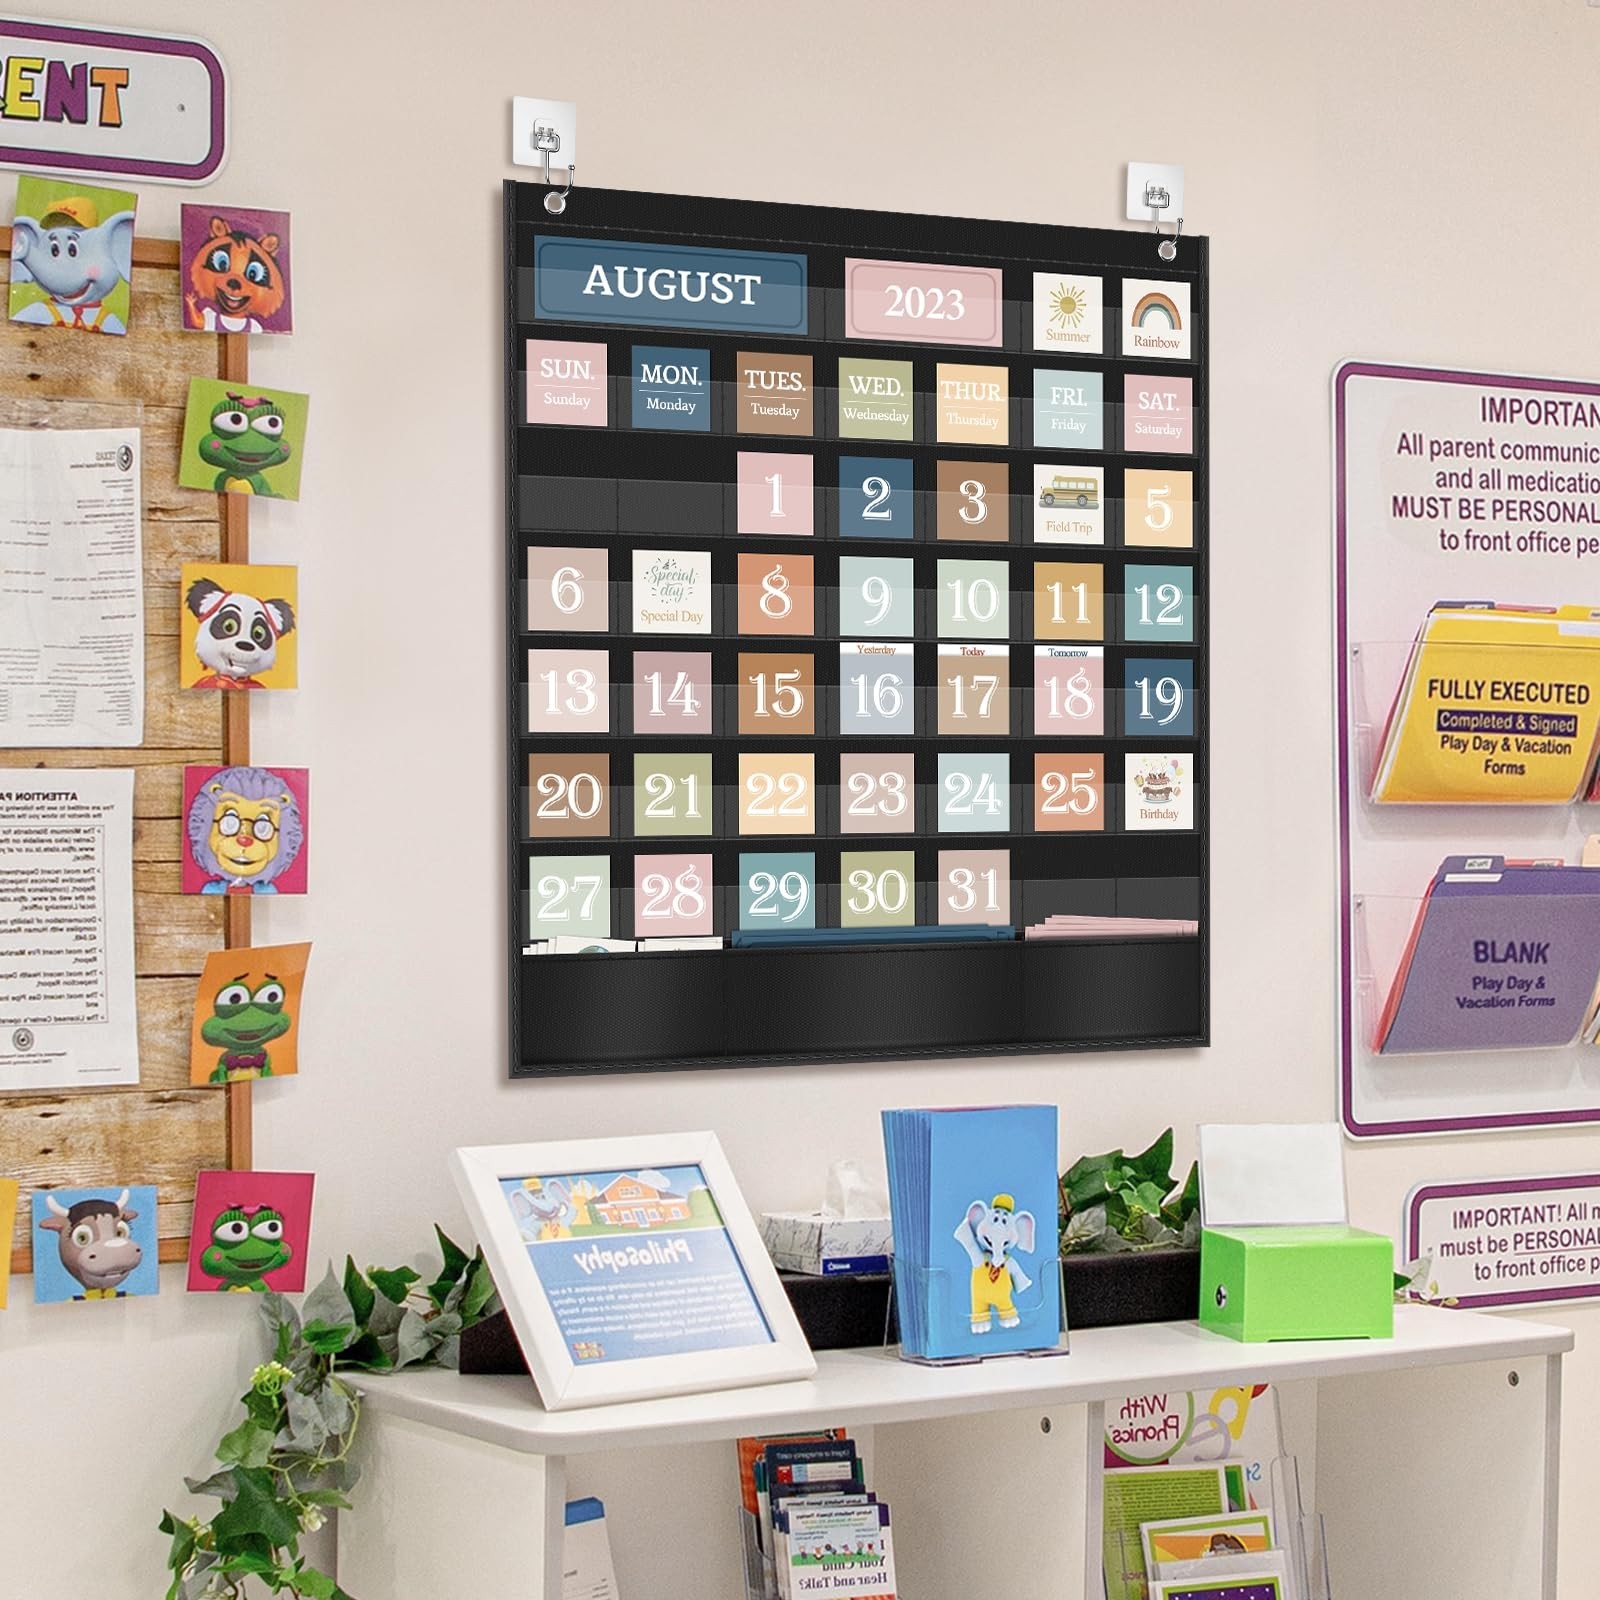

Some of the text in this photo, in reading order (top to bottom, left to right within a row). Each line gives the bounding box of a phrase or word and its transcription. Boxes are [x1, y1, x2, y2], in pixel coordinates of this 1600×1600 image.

[0, 56, 129, 128] ENT
[582, 264, 761, 307] AUGUST
[884, 285, 965, 322] 2023
[1046, 328, 1091, 343] Summer
[1134, 335, 1181, 350] Rainbow
[540, 358, 595, 381] SUN.
[640, 363, 703, 387] MON.
[744, 369, 807, 393] TUES.
[848, 375, 905, 398] WED.
[1050, 386, 1088, 408] FRI.
[543, 392, 591, 409] Sunday
[646, 397, 697, 415] Monday
[750, 402, 800, 420] Tuesday
[1138, 391, 1181, 412] SAT.
[843, 407, 910, 426] Wednesday
[946, 411, 1000, 430] Thursday
[1051, 418, 1087, 434] Friday
[1134, 422, 1183, 439] Saturday
[1397, 432, 1600, 464] All parent communic
[1436, 468, 1600, 494] and all medicatio
[763, 472, 788, 518] 1
[861, 475, 893, 521] 2
[958, 479, 989, 525] 3
[1143, 484, 1174, 531] 5
[1392, 495, 1600, 524] MUST BE PERSONAL
[1046, 520, 1094, 536] Field Trip
[1440, 528, 1460, 551] to
[1465, 528, 1511, 551] front
[1516, 531, 1571, 554] office
[651, 565, 694, 587] Special
[551, 566, 585, 615] 6
[759, 563, 793, 619] 8
[861, 575, 893, 626] 9
[946, 578, 1000, 623] 10
[1046, 581, 1092, 624] 11
[640, 609, 704, 625] Special Day
[1134, 583, 1184, 626] 12
[857, 645, 897, 656] Yesterday
[959, 646, 986, 657] Today
[1048, 648, 1089, 658] Tomorrow
[540, 668, 600, 716] 13
[643, 671, 702, 717] 14
[749, 668, 804, 718] 15
[850, 673, 904, 719] 16
[947, 674, 1000, 719] 17
[1044, 667, 1095, 720] 18
[1134, 676, 1184, 726] 19
[1428, 679, 1590, 705] FULLY EXECUTED
[1439, 711, 1575, 734] Completed & Signed
[1440, 735, 1572, 755] Play Day & Vacation
[1484, 759, 1526, 776] Forms
[536, 772, 603, 820] 20
[644, 772, 702, 818] 21
[745, 772, 808, 817] 22
[847, 771, 908, 816] 23
[944, 771, 1003, 815] 24
[1040, 768, 1099, 815] 25
[1139, 808, 1179, 822] Birthday
[537, 875, 603, 922] 27
[641, 864, 706, 919] 28
[747, 871, 810, 923] 29
[847, 868, 909, 915] 30
[947, 868, 1001, 912] 31
[1473, 940, 1550, 964] BLANK
[1472, 975, 1546, 993] Play Day &
[1456, 995, 1556, 1010] Vacation Forms
[1453, 1203, 1562, 1230] IMPORTANT!
[1566, 1203, 1588, 1222] All
[1440, 1236, 1483, 1257] must
[1487, 1235, 1509, 1253] be
[1475, 1263, 1491, 1281] to
[1495, 1259, 1537, 1279] front
[1539, 1255, 1586, 1275] office
